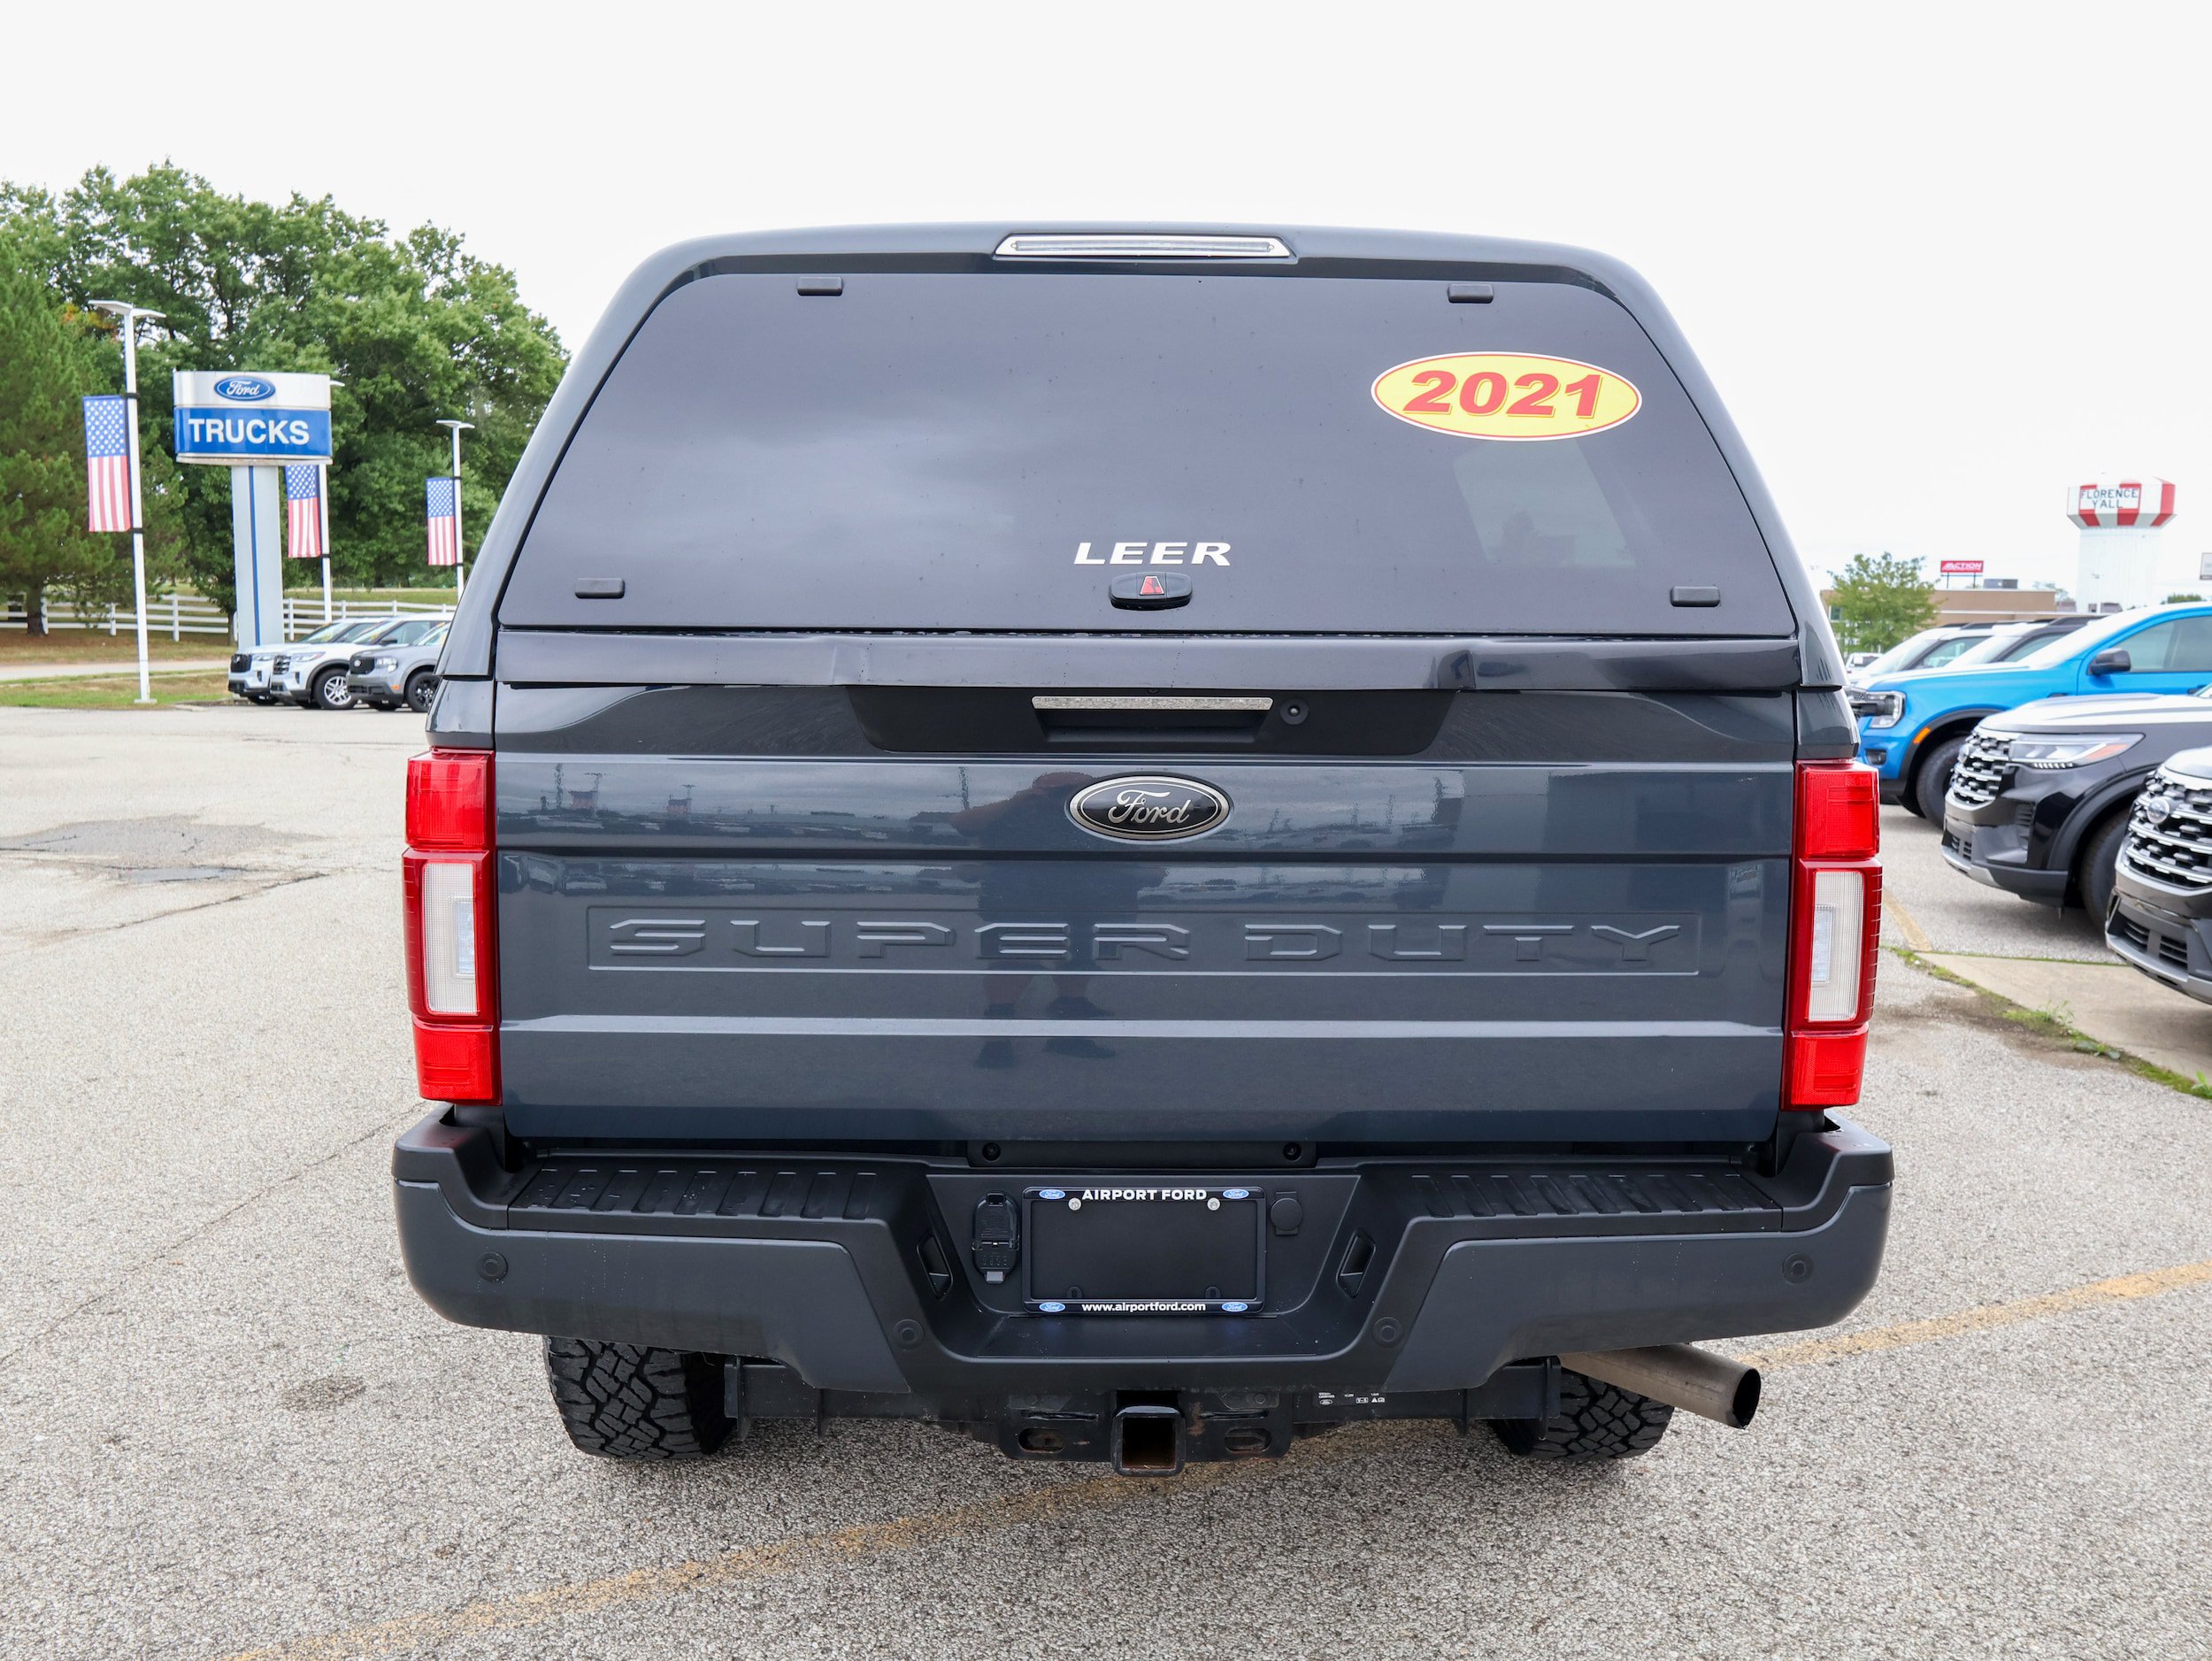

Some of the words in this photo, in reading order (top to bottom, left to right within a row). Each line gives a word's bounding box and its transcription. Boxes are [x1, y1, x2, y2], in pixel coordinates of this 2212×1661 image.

[227, 381, 260, 396] Ford
[1402, 370, 1602, 419] 2021
[188, 419, 310, 445] TRUCKS
[2081, 488, 2138, 498] FLORENCE
[1073, 542, 1232, 566] LEER
[1108, 789, 1191, 824] Ford
[610, 919, 1190, 961] SUPER
[1245, 924, 1680, 961] DUTY
[1081, 1189, 1157, 1200] AIRPORT
[1161, 1189, 1207, 1200] FORD
[1081, 1302, 1206, 1312] www.airportford.com
